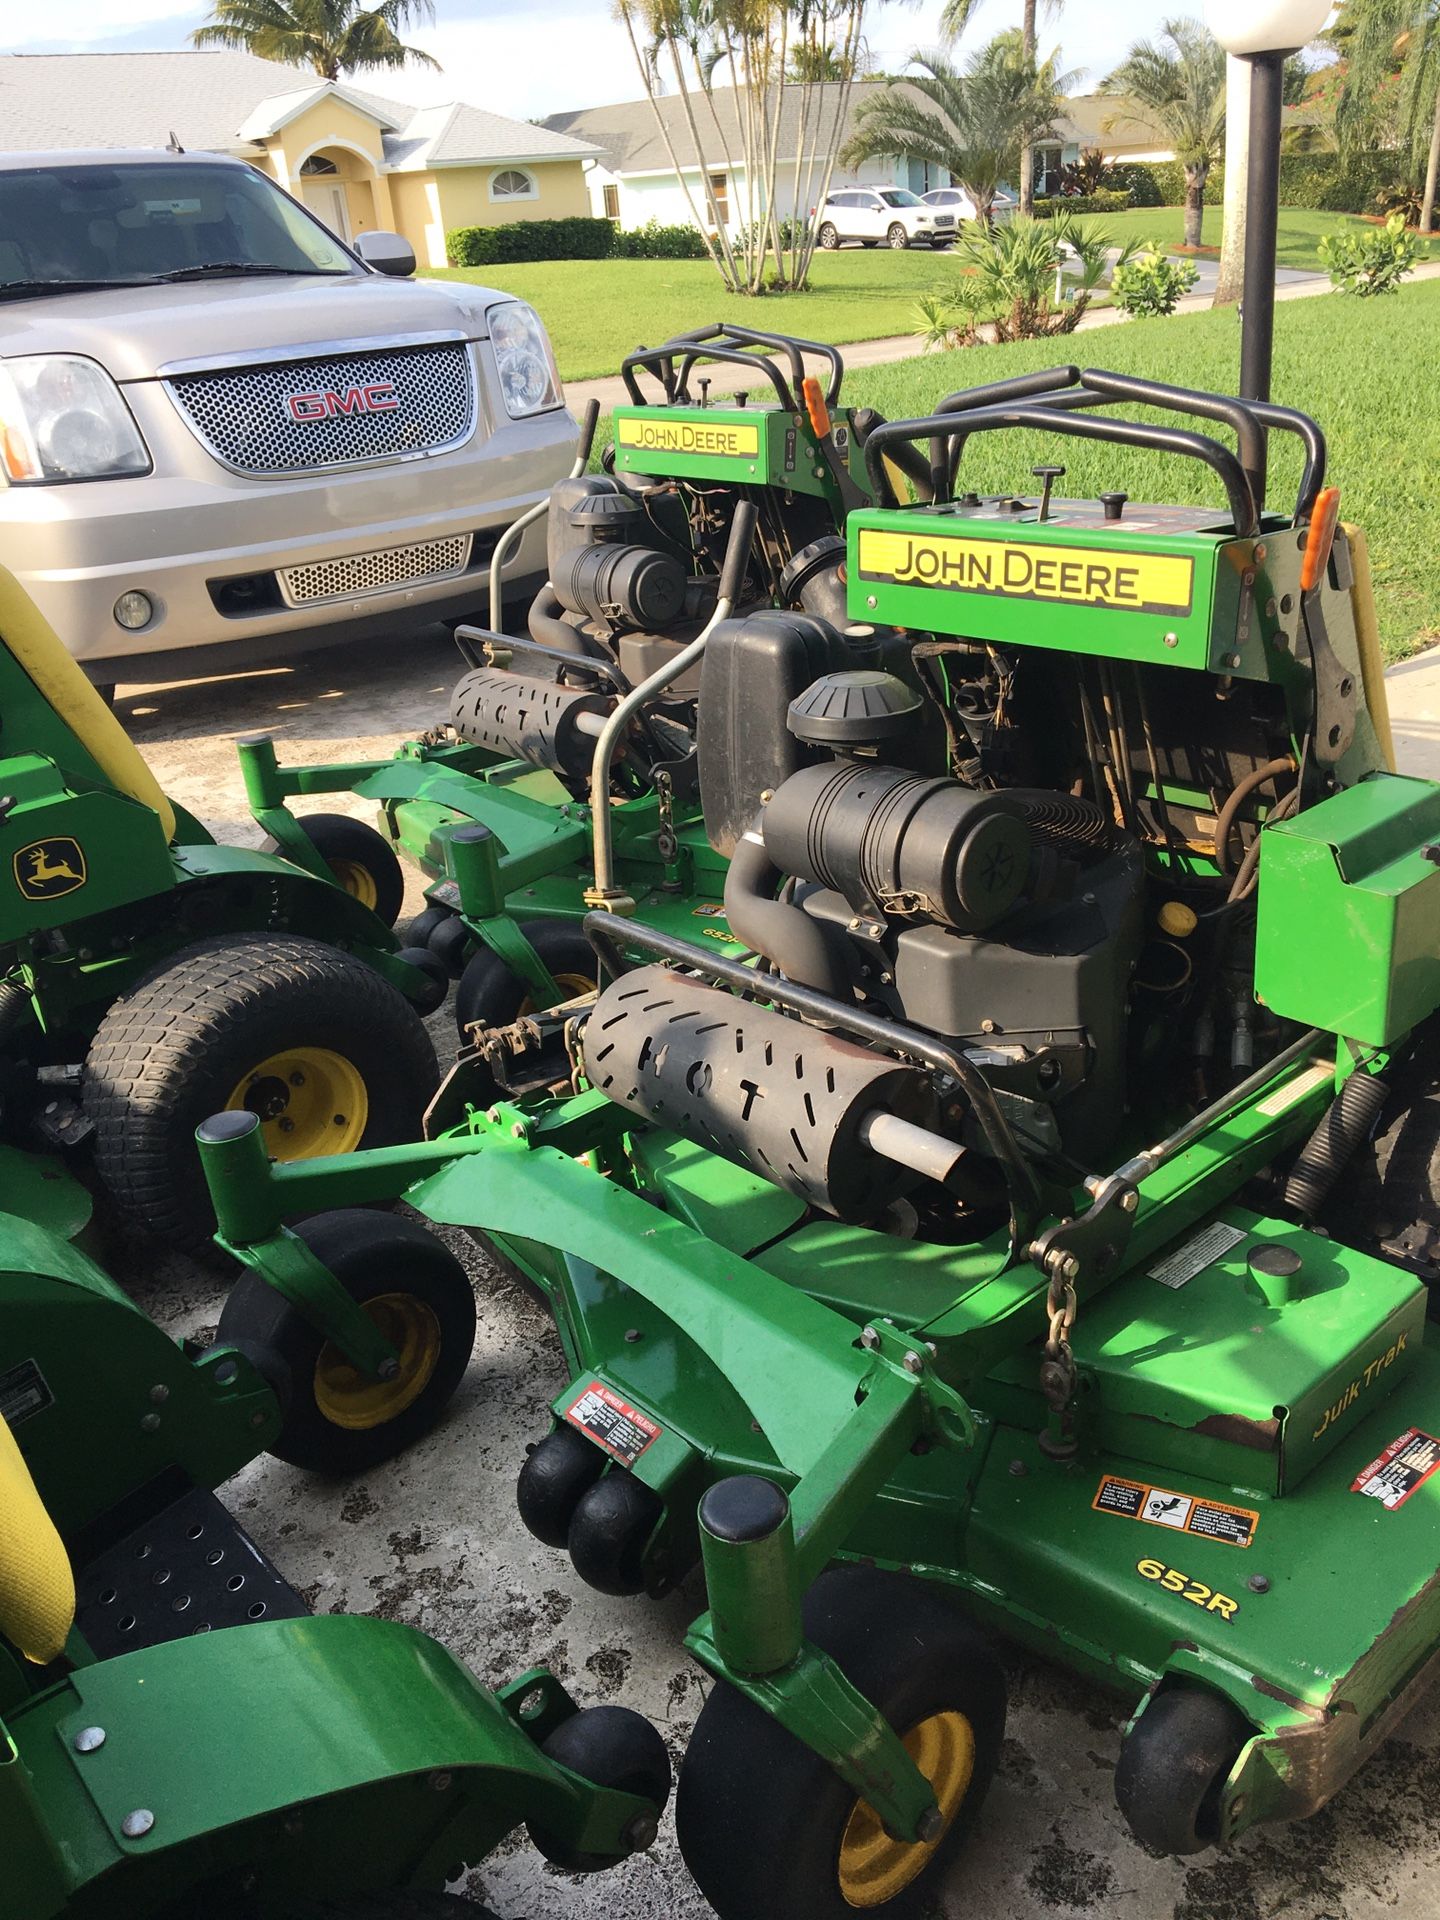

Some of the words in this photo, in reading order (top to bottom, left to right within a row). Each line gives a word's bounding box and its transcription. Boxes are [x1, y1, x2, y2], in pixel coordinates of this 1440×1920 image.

[288, 383, 399, 420] GMC
[635, 424, 678, 447] JOHN
[682, 426, 738, 451] DEERE
[895, 540, 992, 584] JOHN
[1004, 549, 1140, 600] DEERE
[637, 1036, 769, 1122] HOT
[1363, 1332, 1409, 1388] Trak
[602, 1390, 625, 1410] DANGER
[634, 1415, 657, 1434] PELIGRO
[1136, 1559, 1239, 1620] 652R
